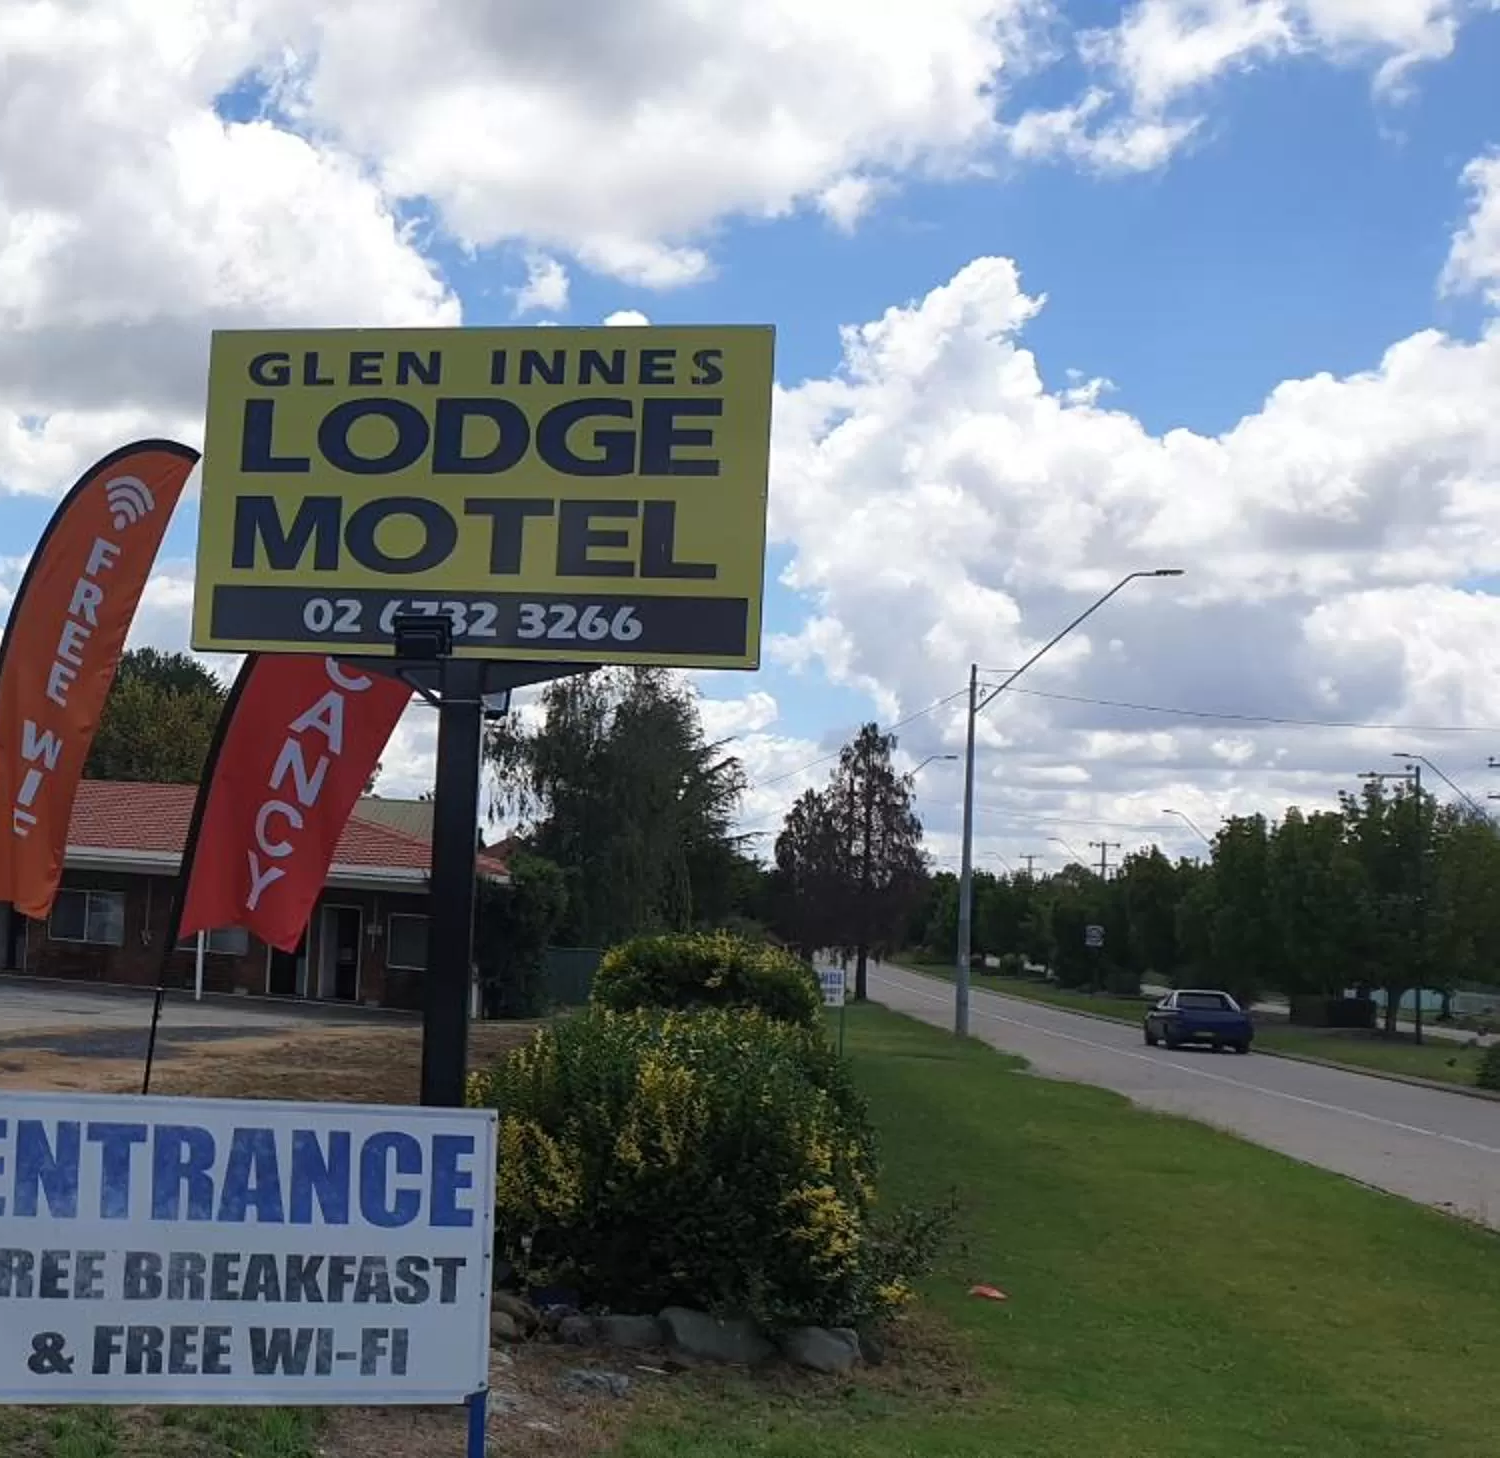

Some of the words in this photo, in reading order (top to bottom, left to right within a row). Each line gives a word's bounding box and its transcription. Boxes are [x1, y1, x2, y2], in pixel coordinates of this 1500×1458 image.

[247, 351, 442, 386] GLEN
[490, 349, 724, 386] INNES
[240, 397, 724, 477] LODGE
[231, 495, 718, 580] MOTEL
[46, 536, 121, 707] FREE
[303, 598, 363, 634] 02
[516, 602, 644, 642] 3266
[123, 1250, 467, 1305] BREAKFAST
[27, 1331, 75, 1375] &
[92, 1325, 232, 1376] FREE
[249, 1326, 409, 1377] WI-FI
